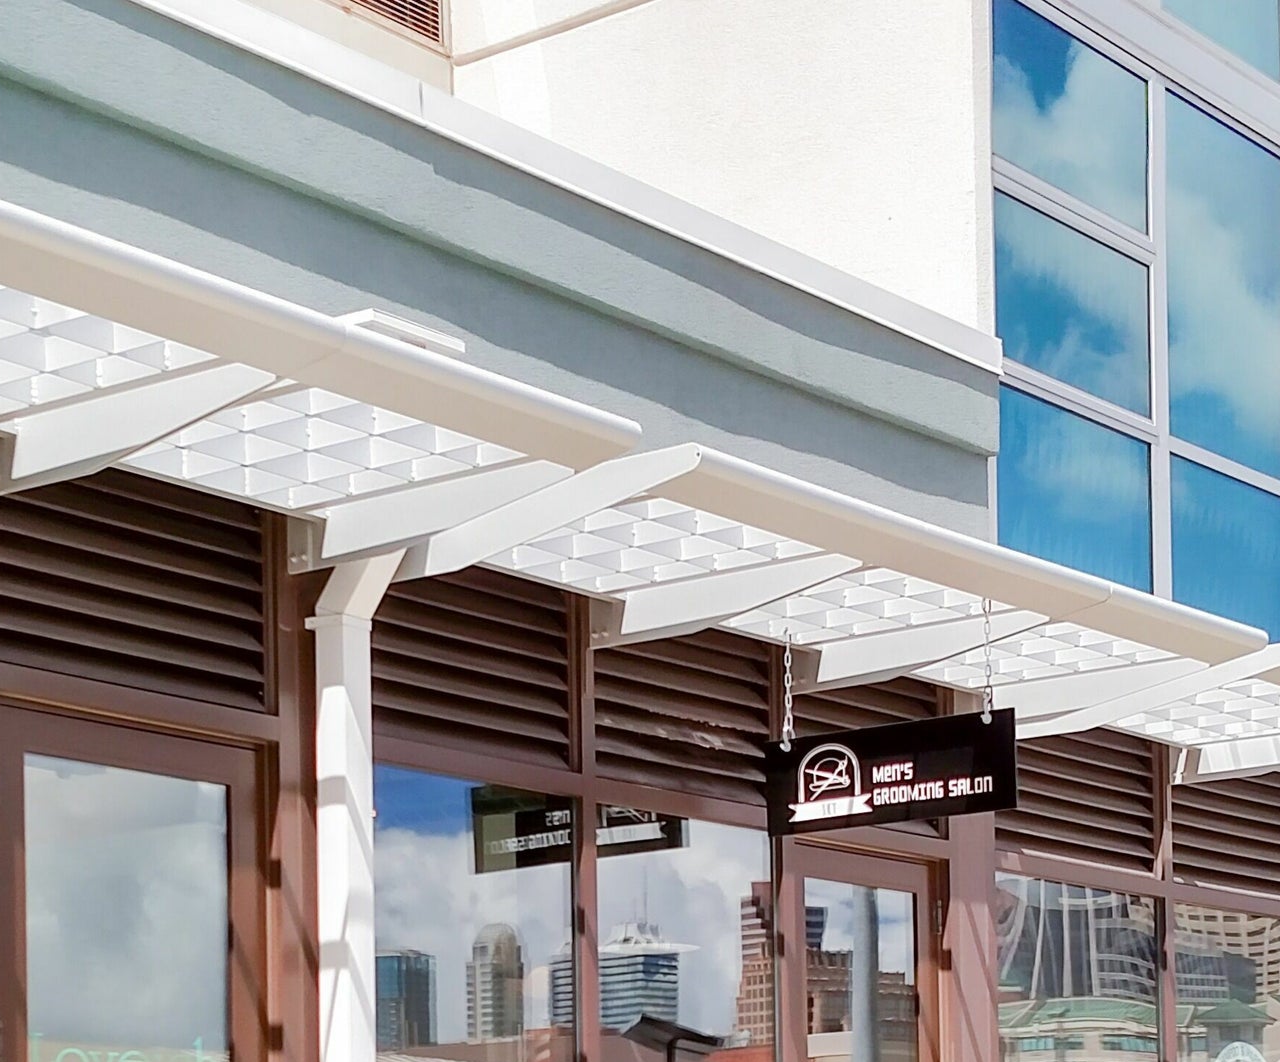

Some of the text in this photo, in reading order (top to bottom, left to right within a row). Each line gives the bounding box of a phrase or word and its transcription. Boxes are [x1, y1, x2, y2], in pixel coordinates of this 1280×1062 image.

[872, 762, 914, 784] Men's
[872, 775, 994, 806] GROOMING SALON
